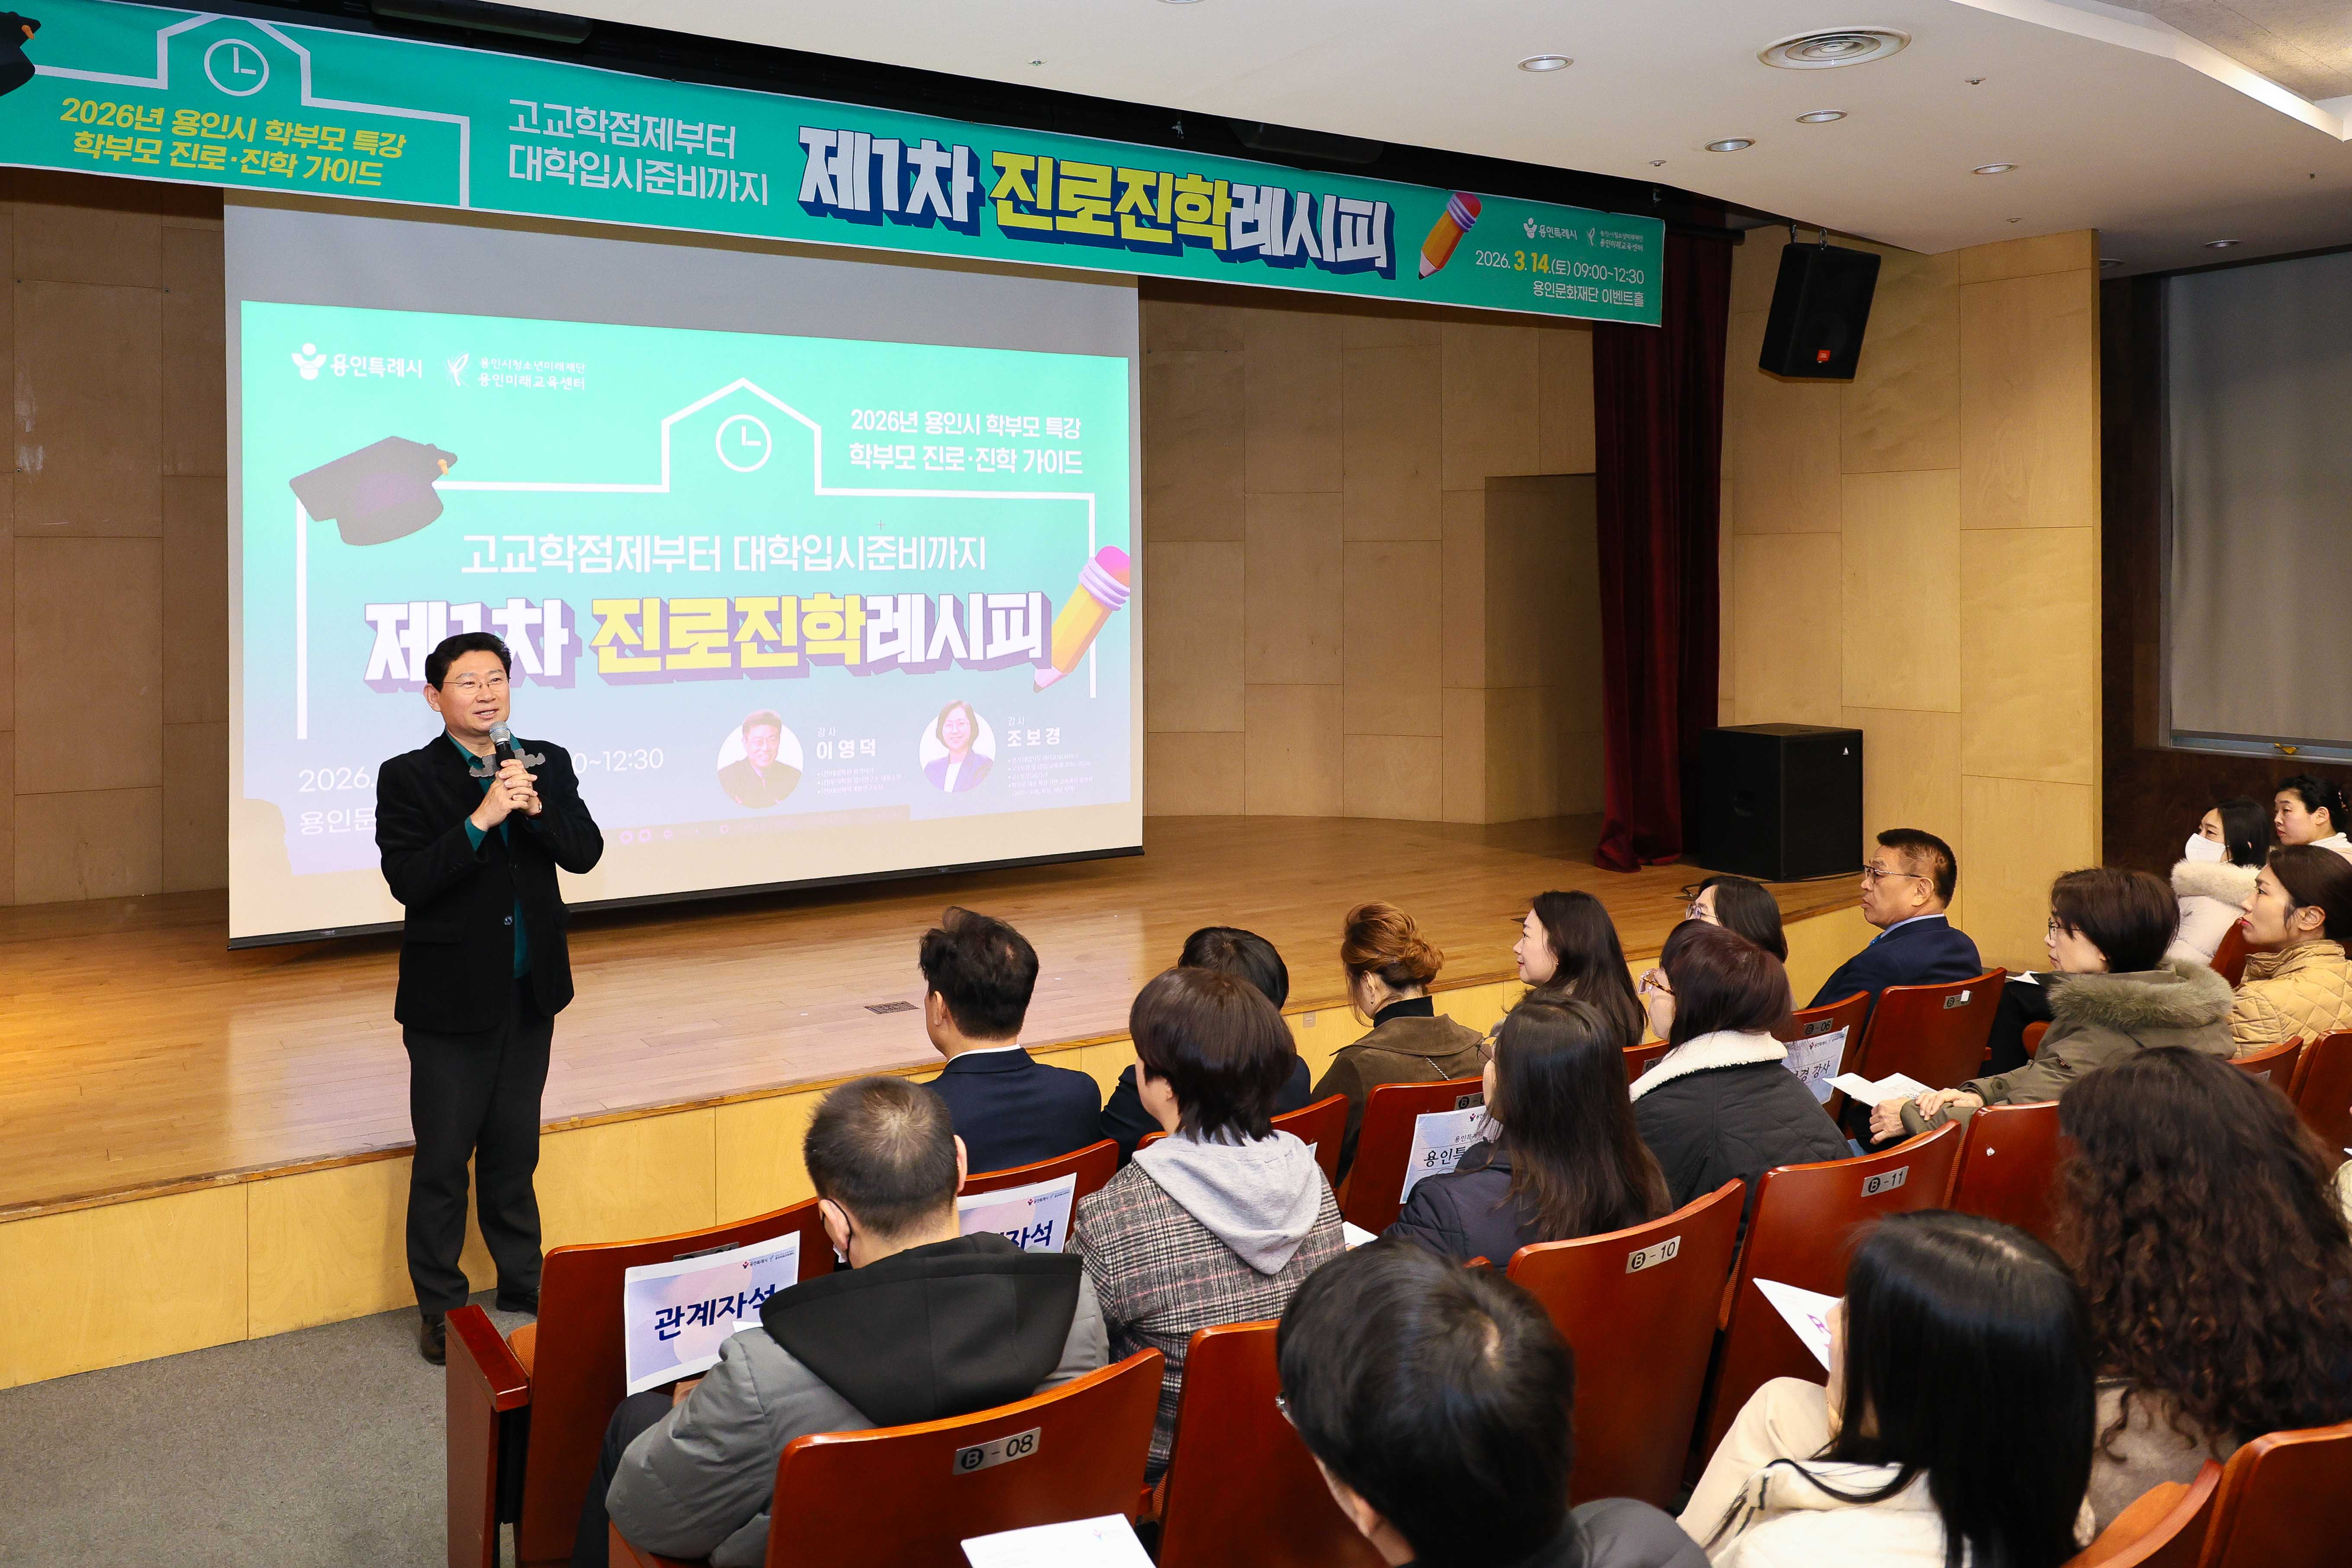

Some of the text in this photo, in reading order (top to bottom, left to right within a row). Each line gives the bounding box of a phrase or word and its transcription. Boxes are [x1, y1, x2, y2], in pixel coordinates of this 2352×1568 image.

[60, 98, 406, 158] 2026년 용인시 학부모 특강
[508, 99, 736, 159] 고교학점제부터
[74, 130, 383, 187] 학부모 진로·진학 가이드
[508, 143, 768, 206] 대학입시준비까지
[799, 126, 1387, 268] 제1차 진로진학레시피
[1539, 224, 1578, 240] 용인특례시
[1475, 250, 1510, 269] 2026.
[1514, 250, 1527, 271] 3.
[1574, 262, 1644, 284] 09:00~12:30
[1533, 280, 1644, 307] 용인문화재단 이벤트홀
[330, 353, 423, 379] 용인특례시
[478, 372, 585, 391] 용인미래교육센터
[479, 357, 586, 374] 용인시청소년미래재단
[850, 409, 1081, 439] 2026년 용인시 학부모 특강
[849, 442, 1083, 474] 학부모 진로·진학 가이드
[461, 534, 986, 574] 고교학점제부터 대학입시준비까지
[590, 592, 1042, 673] 진로진학레시피
[298, 766, 375, 791] 2026.
[1812, 1060, 1830, 1078] 강사
